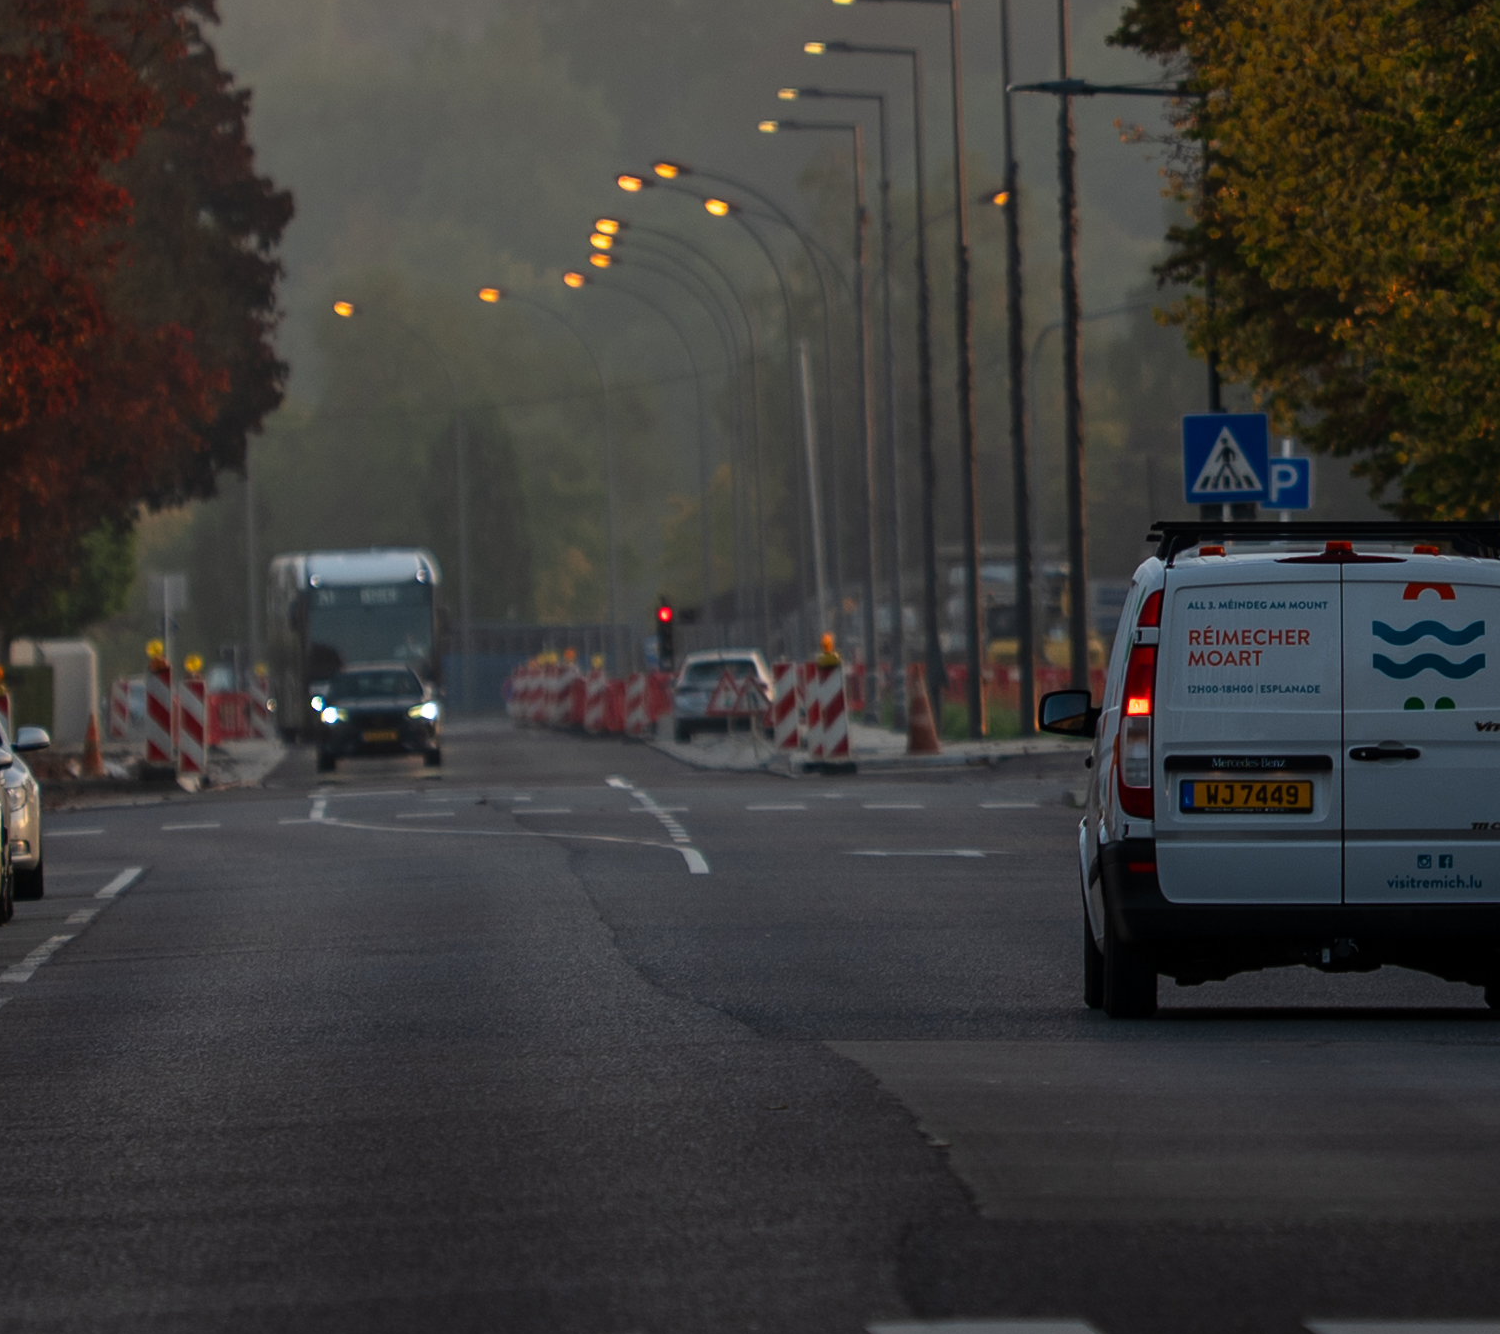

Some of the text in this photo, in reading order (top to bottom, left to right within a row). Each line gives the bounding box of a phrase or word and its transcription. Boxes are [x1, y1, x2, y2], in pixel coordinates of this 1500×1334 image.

[1271, 463, 1299, 503] P
[1187, 598, 1329, 610] ALL 3. MÉINDEG AM MOUNT
[1188, 624, 1311, 646] RÉIMECHER
[1187, 650, 1263, 667] MOART
[1187, 684, 1321, 694] 12H00-18H00 ESPLANADE
[1211, 757, 1287, 768] Mercedes-Benz
[1206, 784, 1235, 805] WJ
[1241, 784, 1299, 805] 7449
[1387, 874, 1483, 889] visitremich.lu
